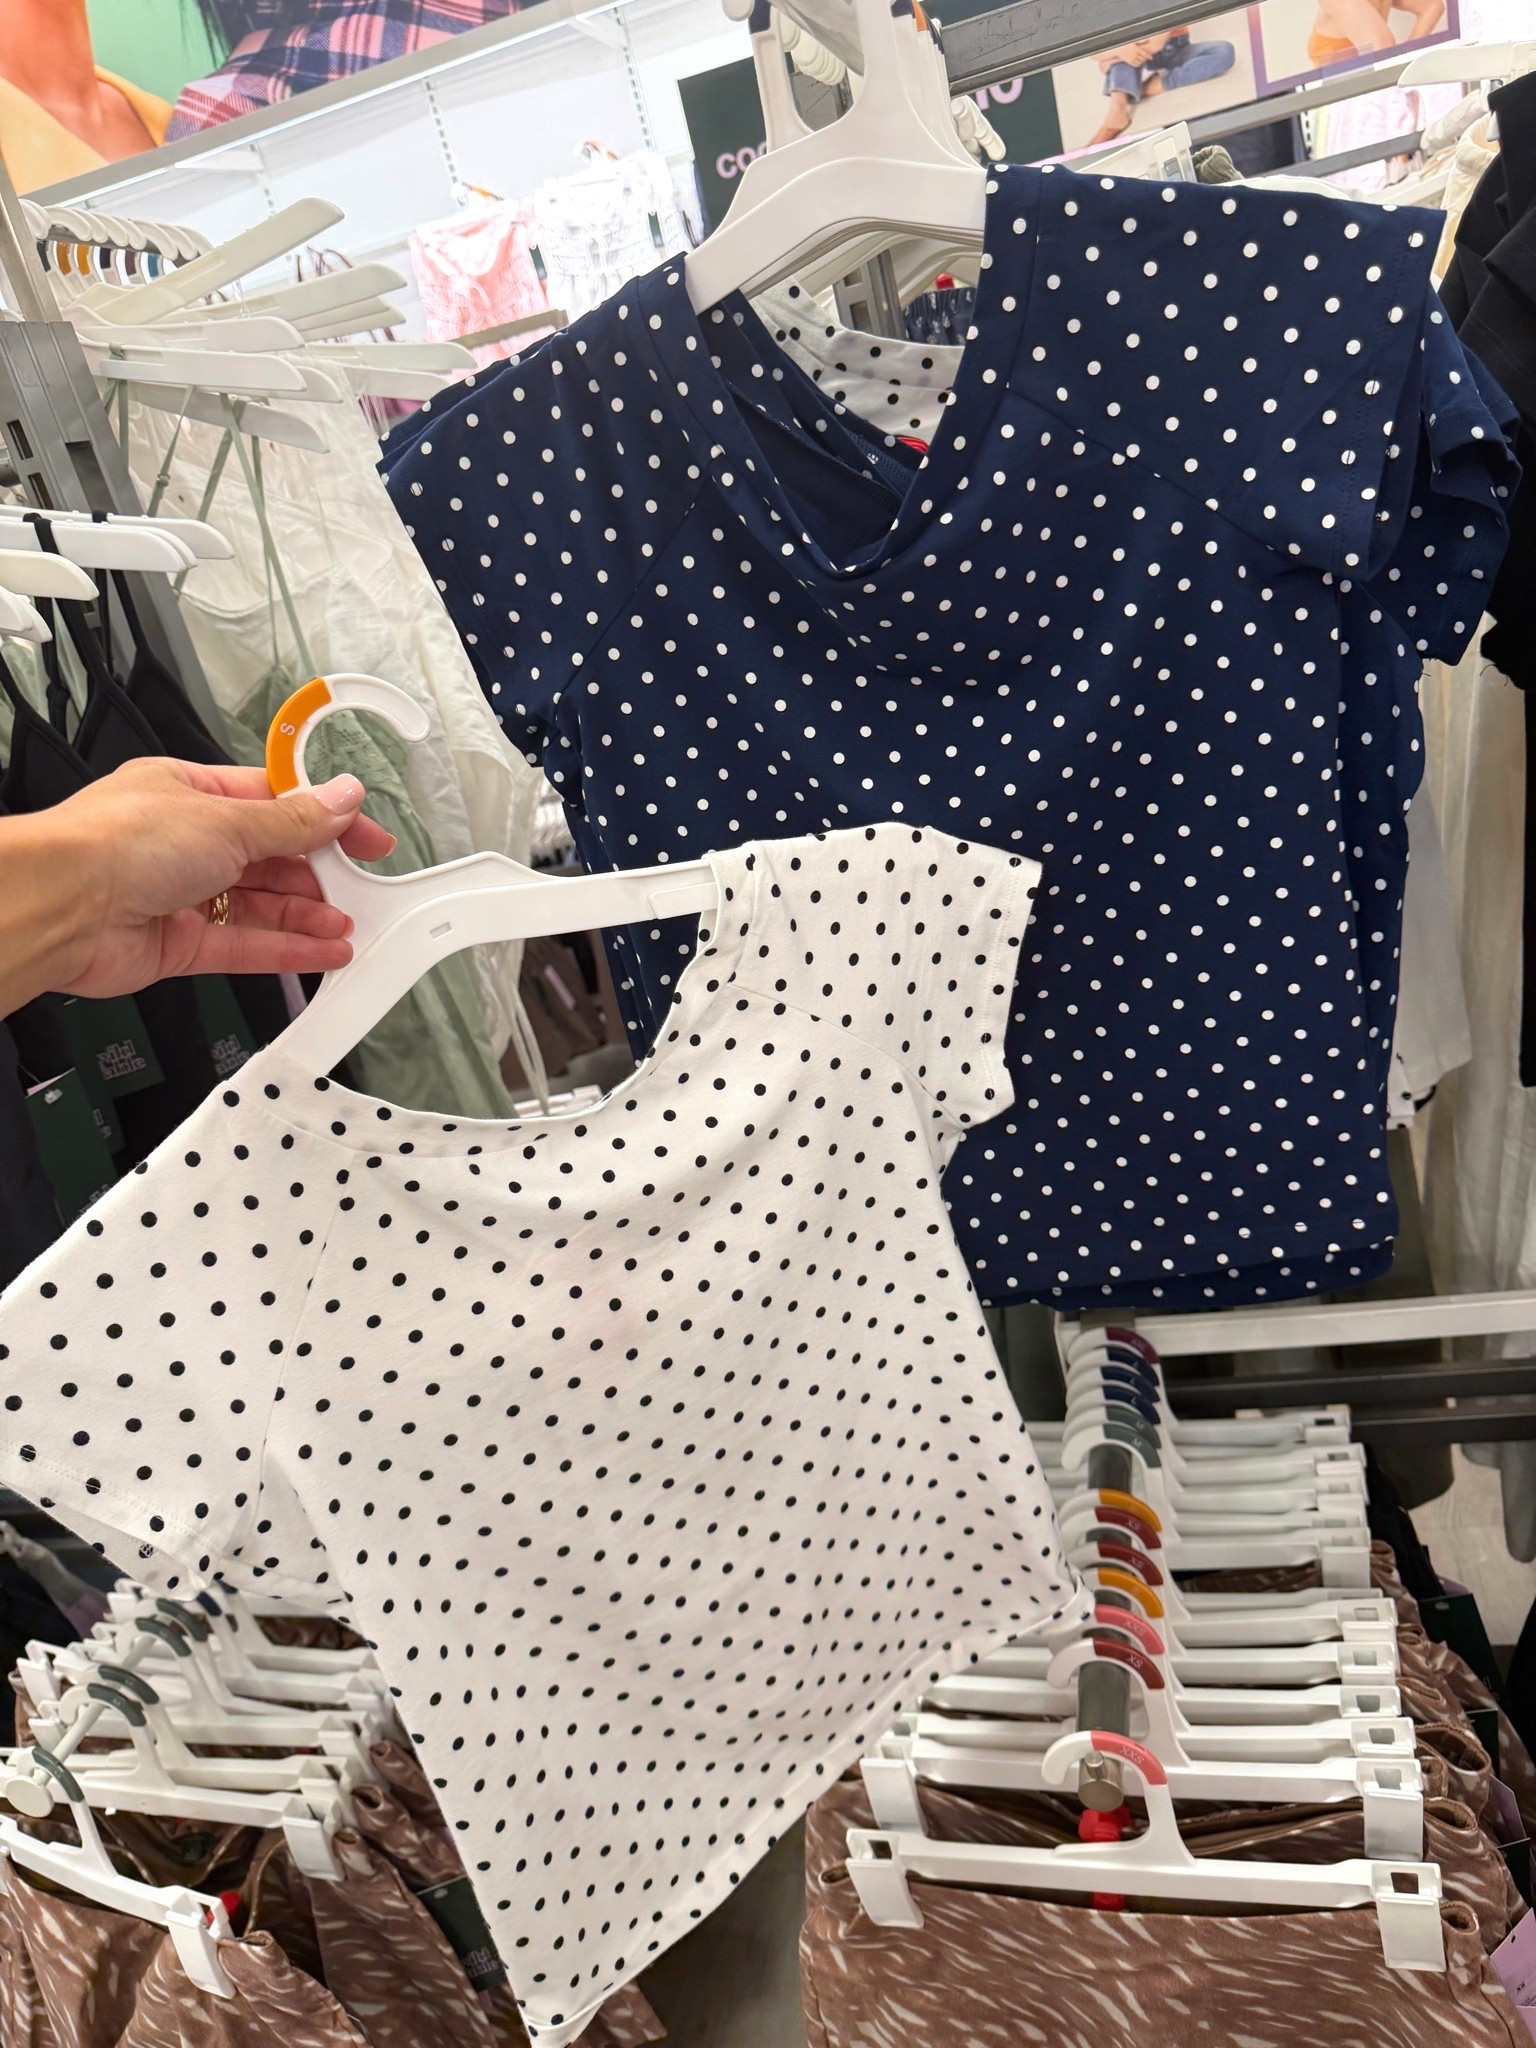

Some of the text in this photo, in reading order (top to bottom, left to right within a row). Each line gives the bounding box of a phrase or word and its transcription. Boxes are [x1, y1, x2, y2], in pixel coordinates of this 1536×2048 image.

[280, 723, 295, 736] S
[1126, 1653, 1143, 1668] XS
[1121, 1746, 1145, 1765] XXS
